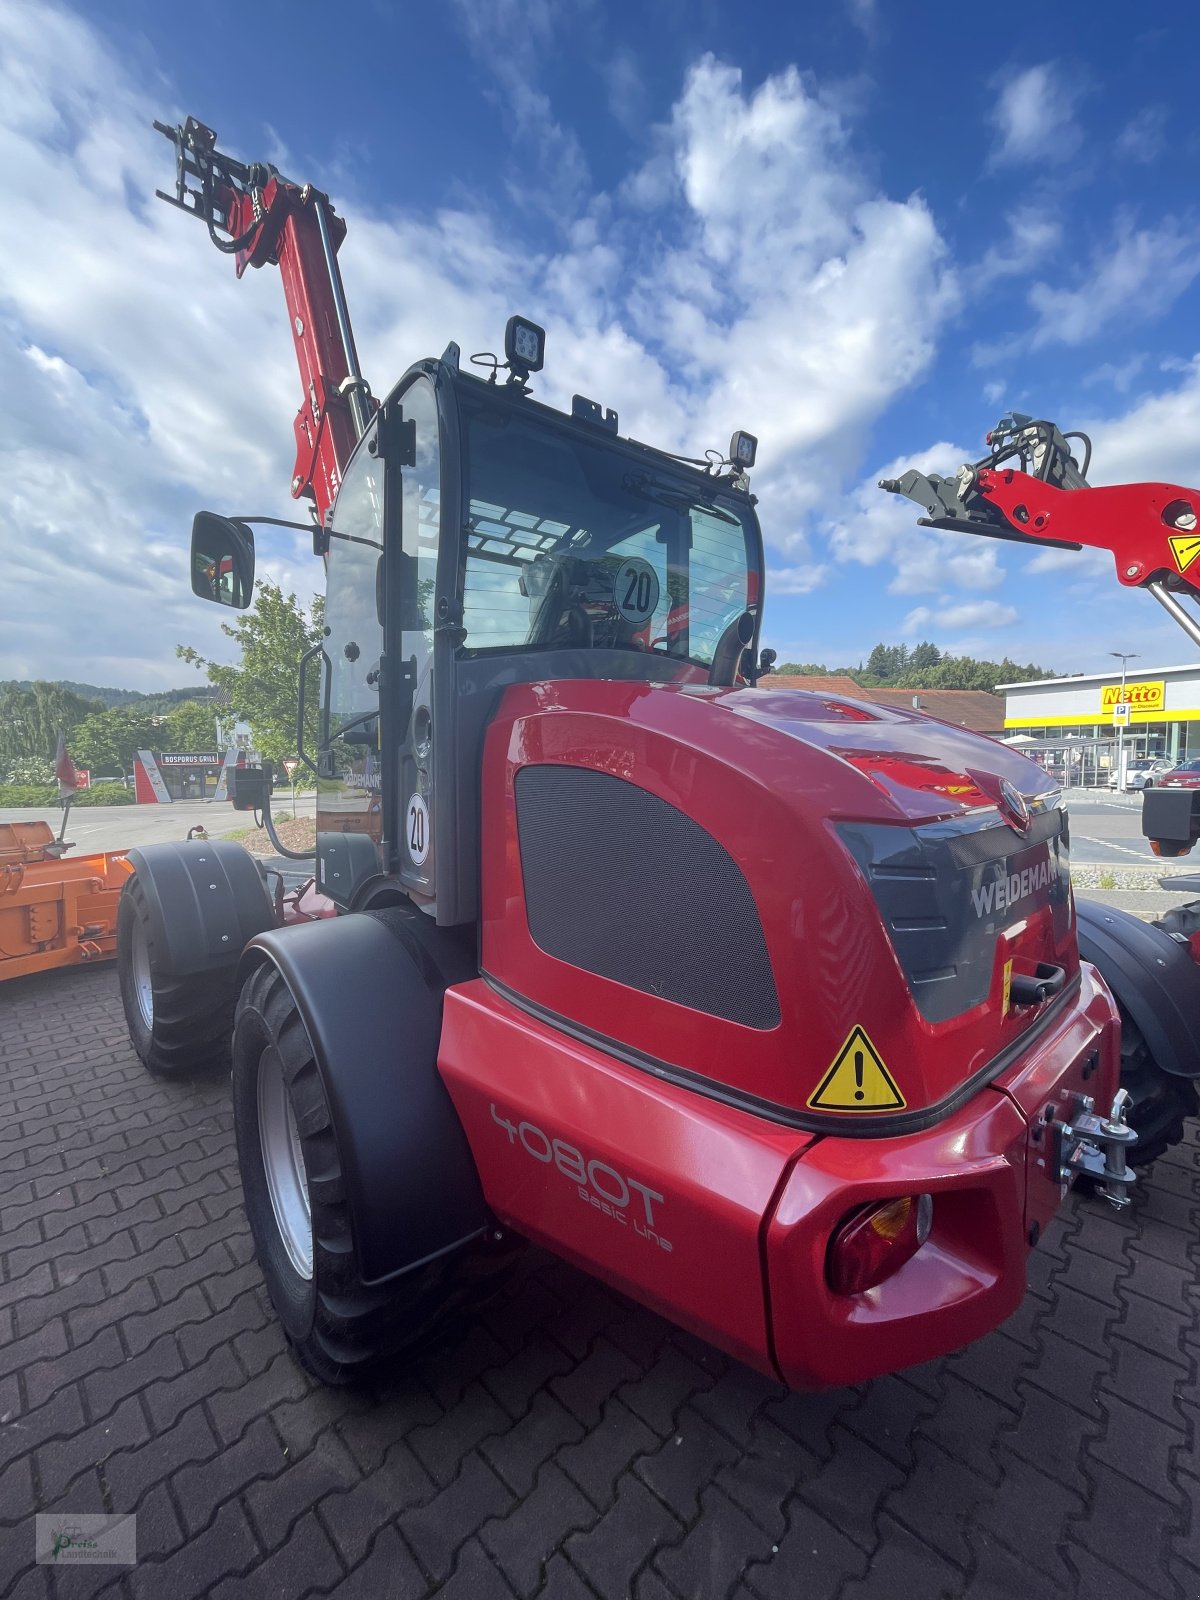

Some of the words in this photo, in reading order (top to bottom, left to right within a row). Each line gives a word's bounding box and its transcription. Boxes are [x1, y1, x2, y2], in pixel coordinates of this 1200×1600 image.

[622, 567, 652, 613] 20
[1103, 686, 1161, 705] Netto
[164, 755, 198, 763] BOSPORUS
[199, 755, 215, 763] GRILL
[410, 805, 424, 853] 20
[489, 1102, 664, 1227] 4080T
[632, 1218, 673, 1253] Line
